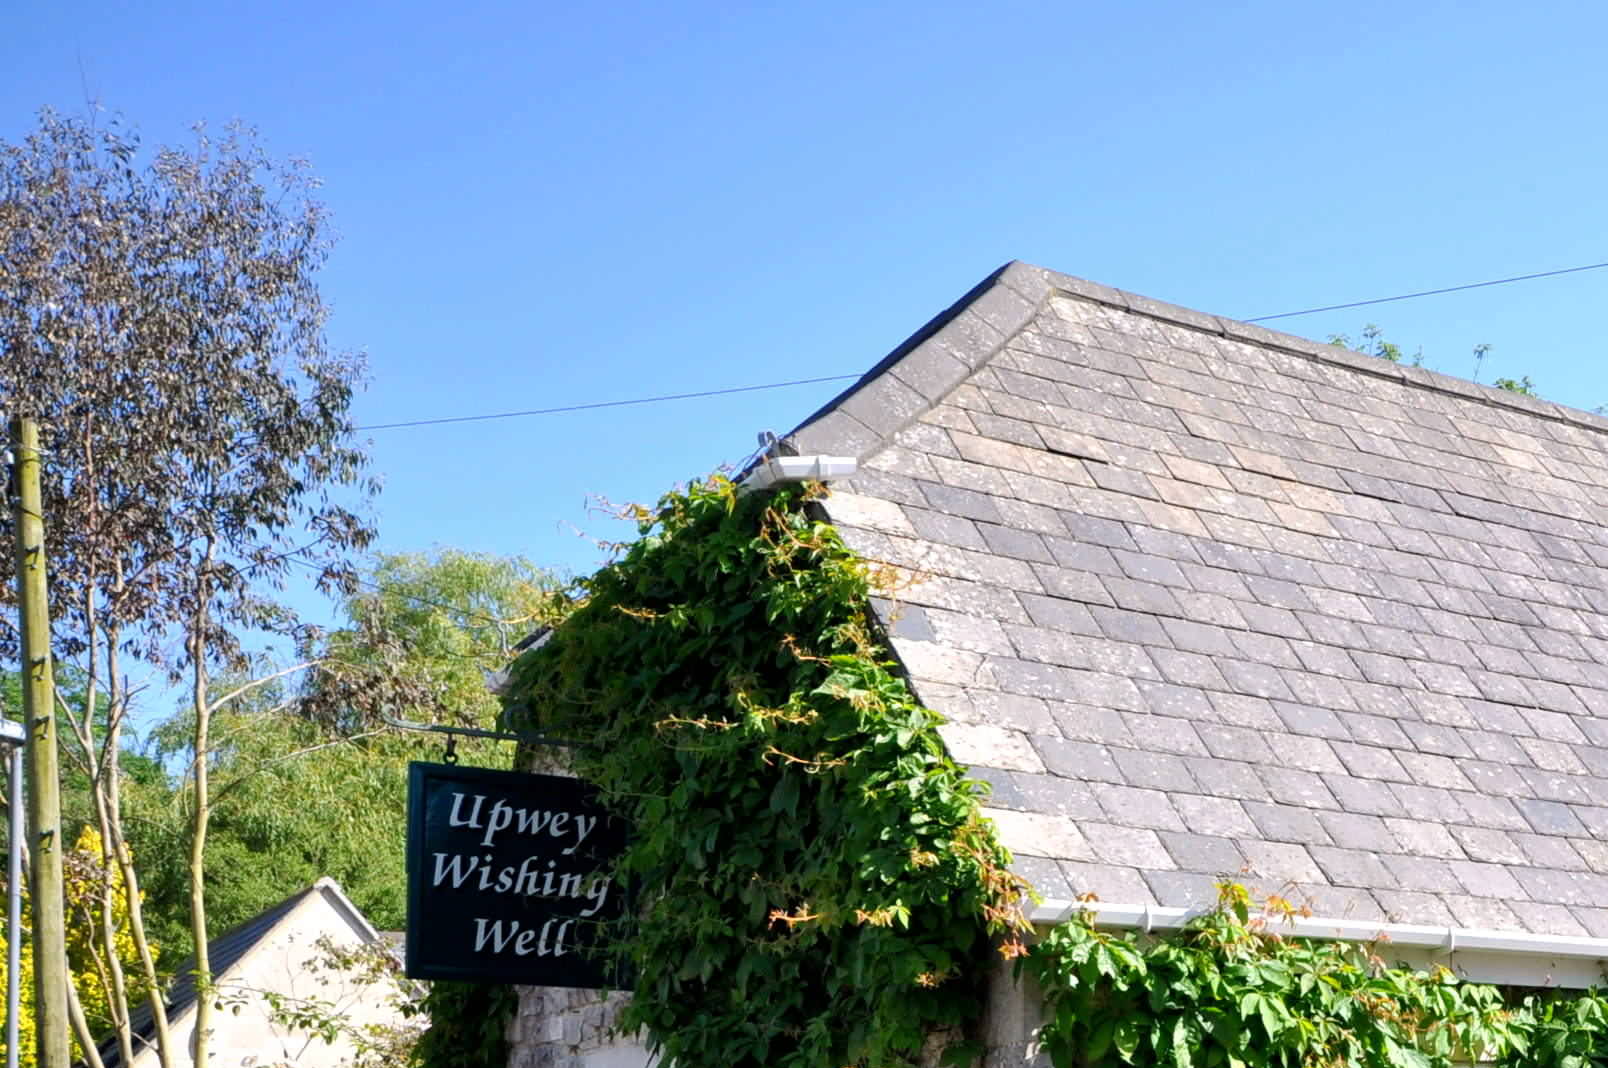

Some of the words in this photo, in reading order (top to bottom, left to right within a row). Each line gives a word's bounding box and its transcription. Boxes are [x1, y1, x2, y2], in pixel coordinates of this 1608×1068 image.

[450, 792, 597, 855] Upwey
[432, 852, 613, 917] Wishing
[473, 918, 575, 957] Well
